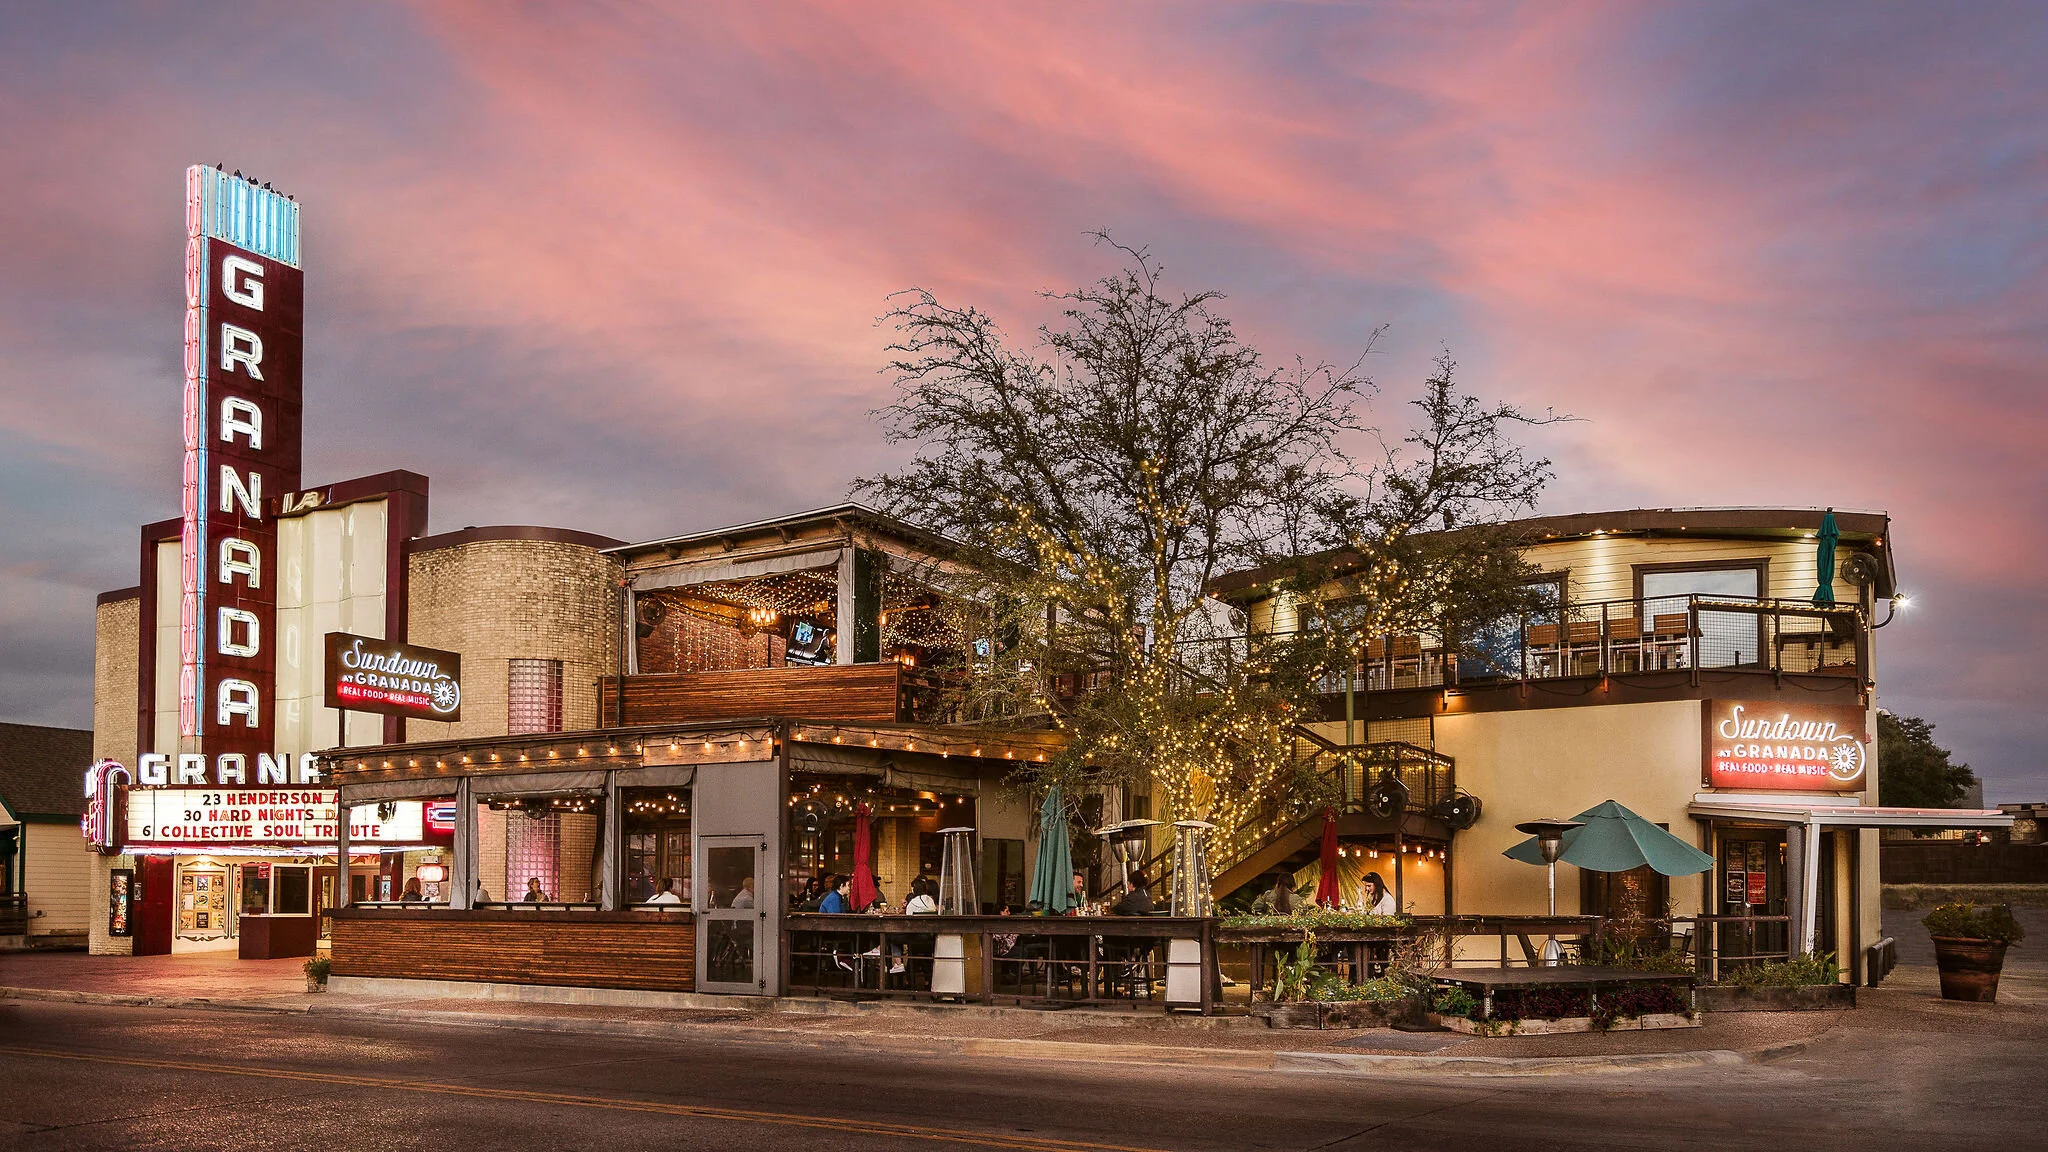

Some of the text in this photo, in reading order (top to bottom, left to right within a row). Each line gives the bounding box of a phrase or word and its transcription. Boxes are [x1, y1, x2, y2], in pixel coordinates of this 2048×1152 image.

[217, 255, 264, 729] GRANADA
[342, 639, 451, 680] Sundown
[342, 672, 432, 695] AT GRANADA
[343, 686, 430, 706] REAL FOOD REAL MUSIC
[1719, 705, 1854, 742] Sundown
[1718, 744, 1829, 761] AT GRANADA
[1719, 762, 1826, 776] REAL FOOD REAL MUSIC
[203, 794, 221, 806] 23
[227, 792, 322, 806] HENDERSON
[184, 810, 202, 821] 30
[209, 809, 251, 822] HARD
[258, 809, 314, 822] NIGHTS
[142, 824, 381, 838] 6 COLLECTIVE SOUL TRIUTE
